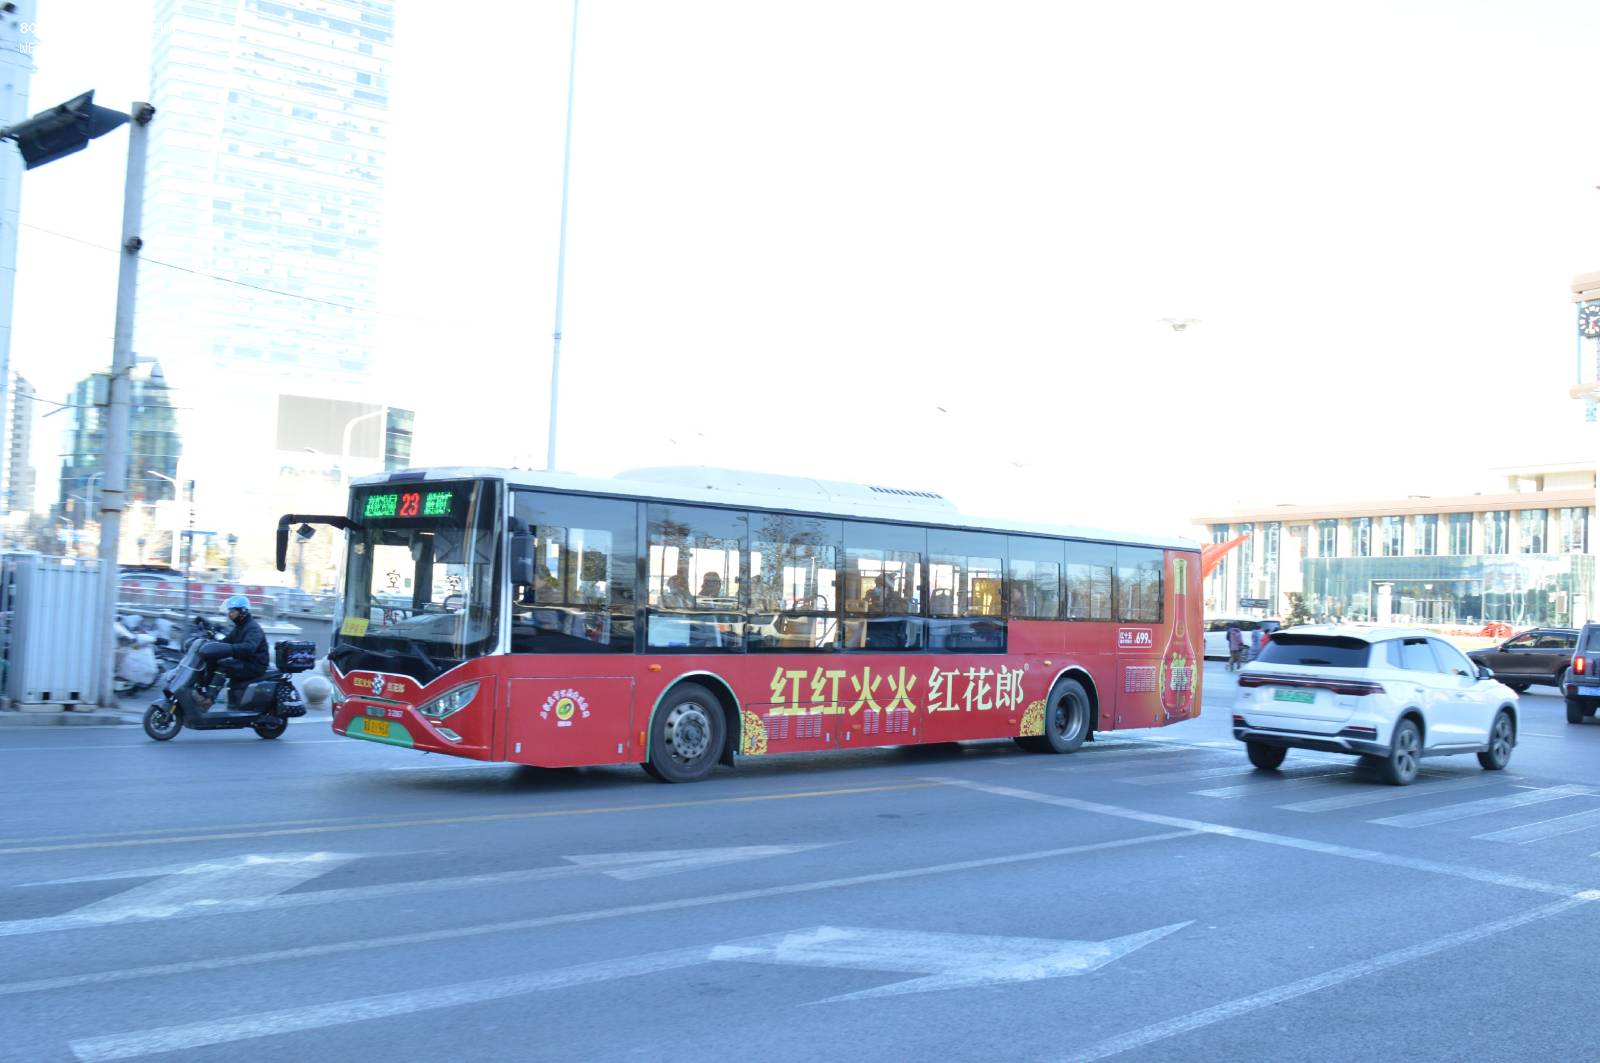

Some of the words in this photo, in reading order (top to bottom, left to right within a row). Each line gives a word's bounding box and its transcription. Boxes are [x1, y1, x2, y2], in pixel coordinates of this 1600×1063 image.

[399, 492, 421, 516] 23
[769, 666, 917, 716] 红红火火
[927, 664, 1025, 714] 红花郎
